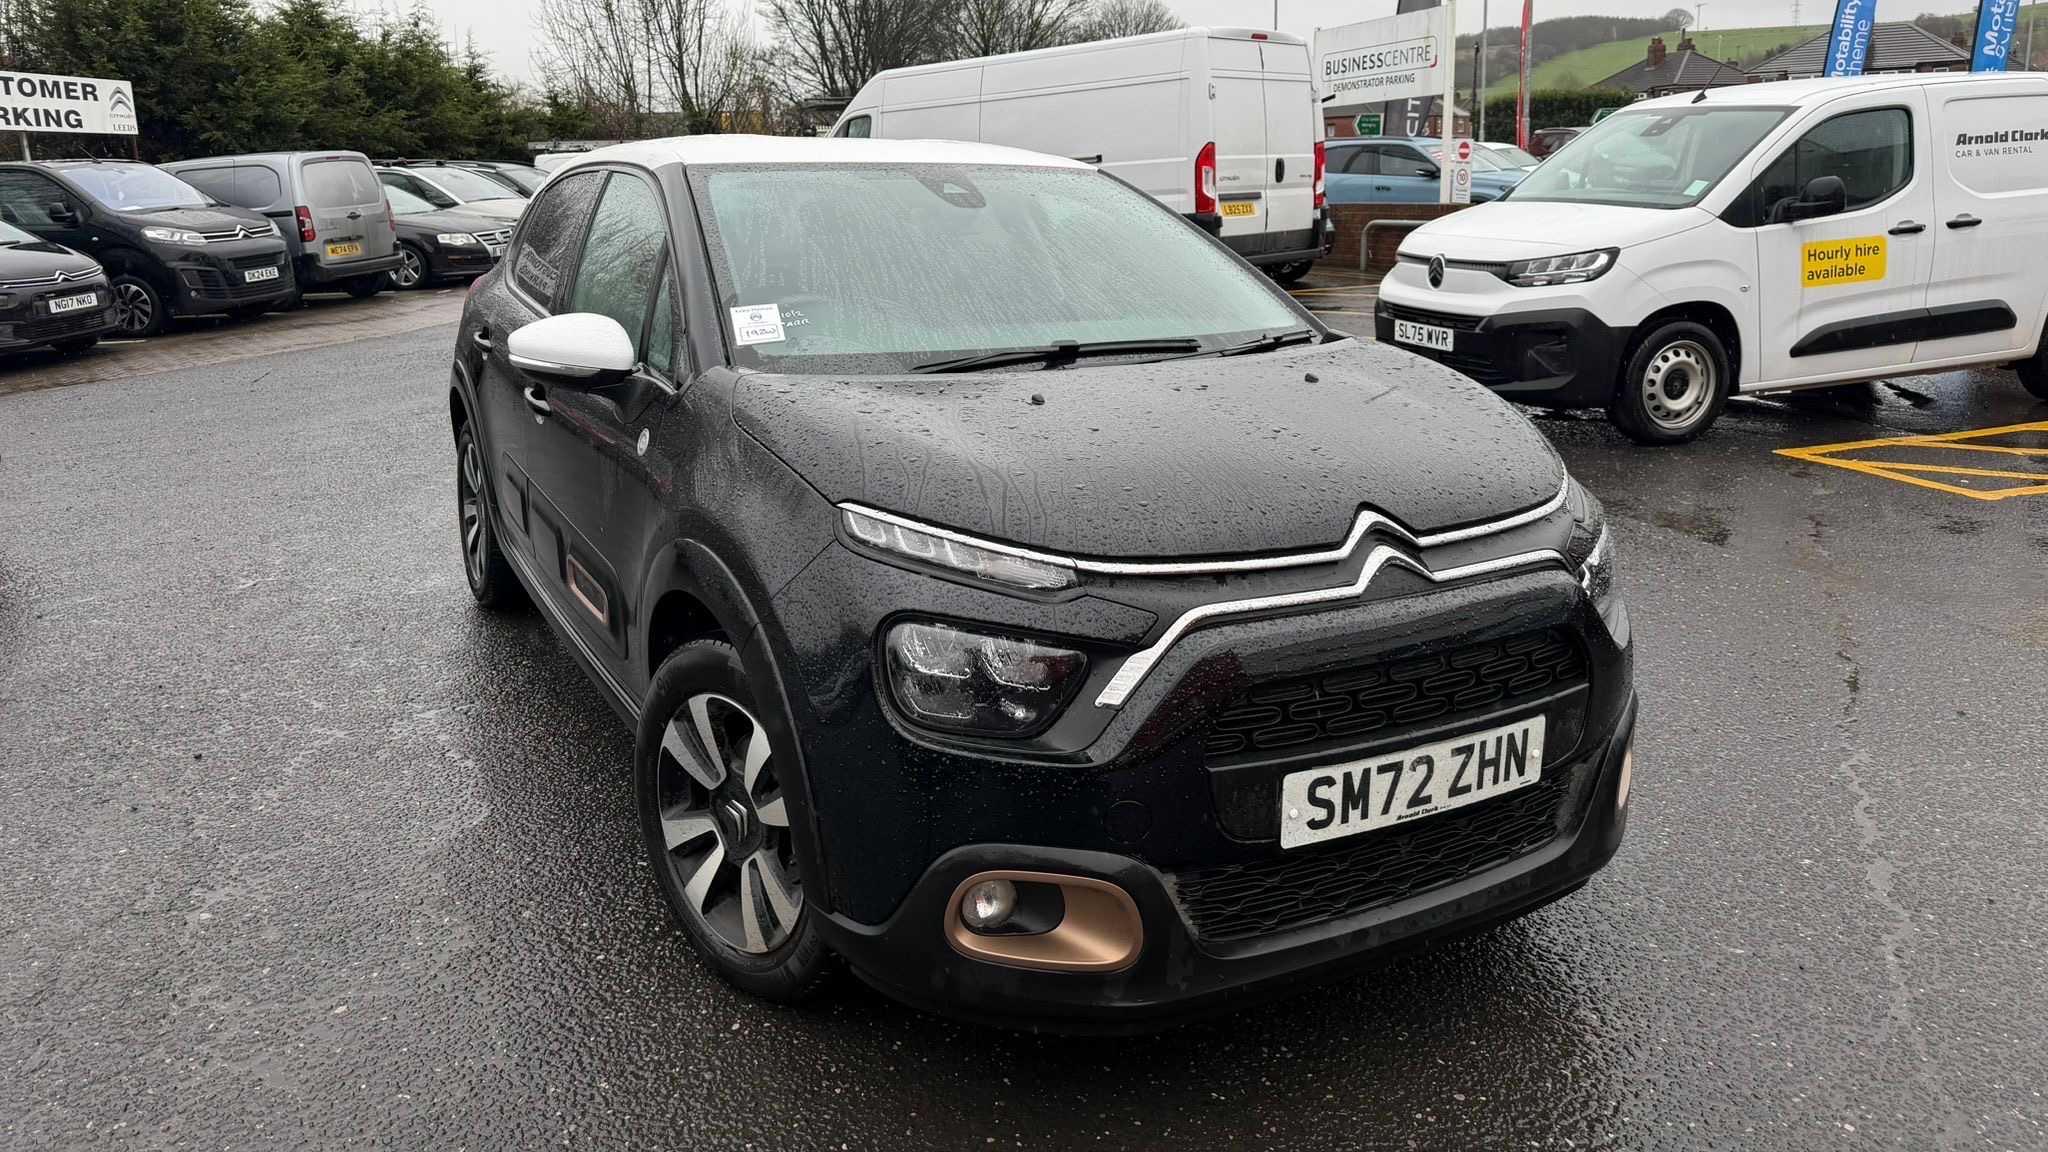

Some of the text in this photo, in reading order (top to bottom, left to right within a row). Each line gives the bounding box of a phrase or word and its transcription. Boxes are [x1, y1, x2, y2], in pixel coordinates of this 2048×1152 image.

[0, 76, 99, 101] TOMER
[1333, 73, 1415, 92] DEMONSTRATOR PARKING
[0, 106, 83, 128] RKING
[1955, 131, 2008, 146] Arnold
[1955, 149, 1972, 158] CAR
[1984, 148, 1999, 156] VAN
[2002, 146, 2032, 155] RENTAL
[1807, 243, 1880, 262] Hourly hire
[1807, 263, 1866, 281] available
[1399, 323, 1448, 347] SL75 WVR
[1306, 728, 1529, 830] SM72 ZHN
